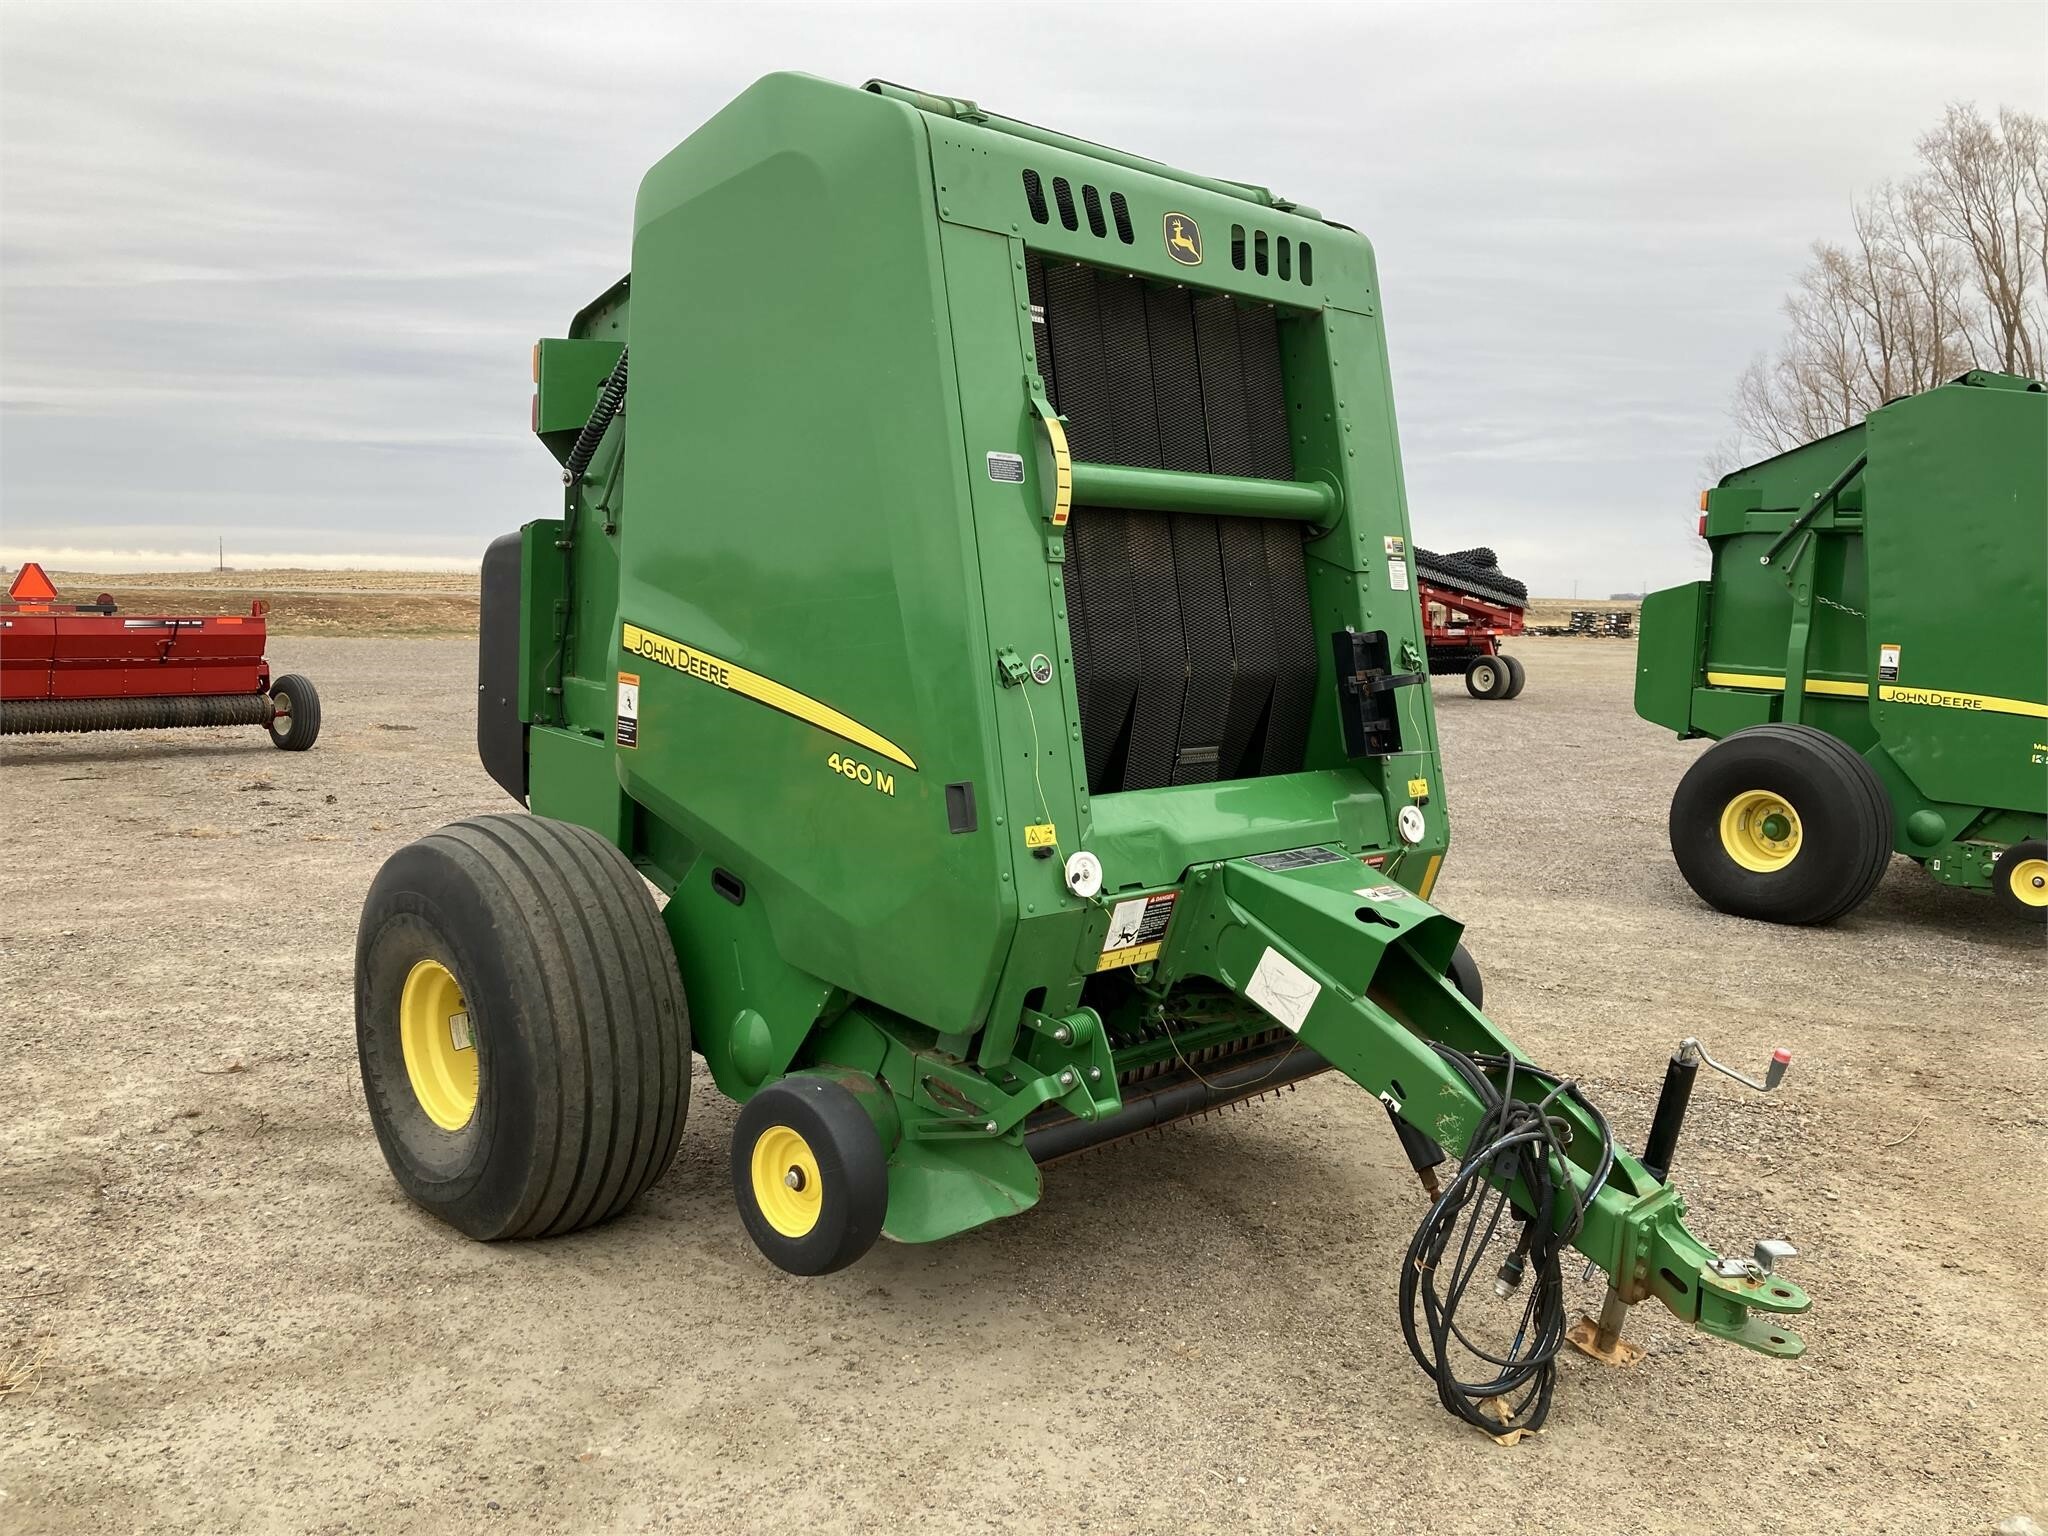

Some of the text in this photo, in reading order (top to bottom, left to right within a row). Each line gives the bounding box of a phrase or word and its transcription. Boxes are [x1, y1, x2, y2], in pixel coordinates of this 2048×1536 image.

[635, 633, 729, 686] JOHN DEERE
[1887, 690, 1983, 709] JOHN DEERE
[827, 752, 895, 797] 460 M
